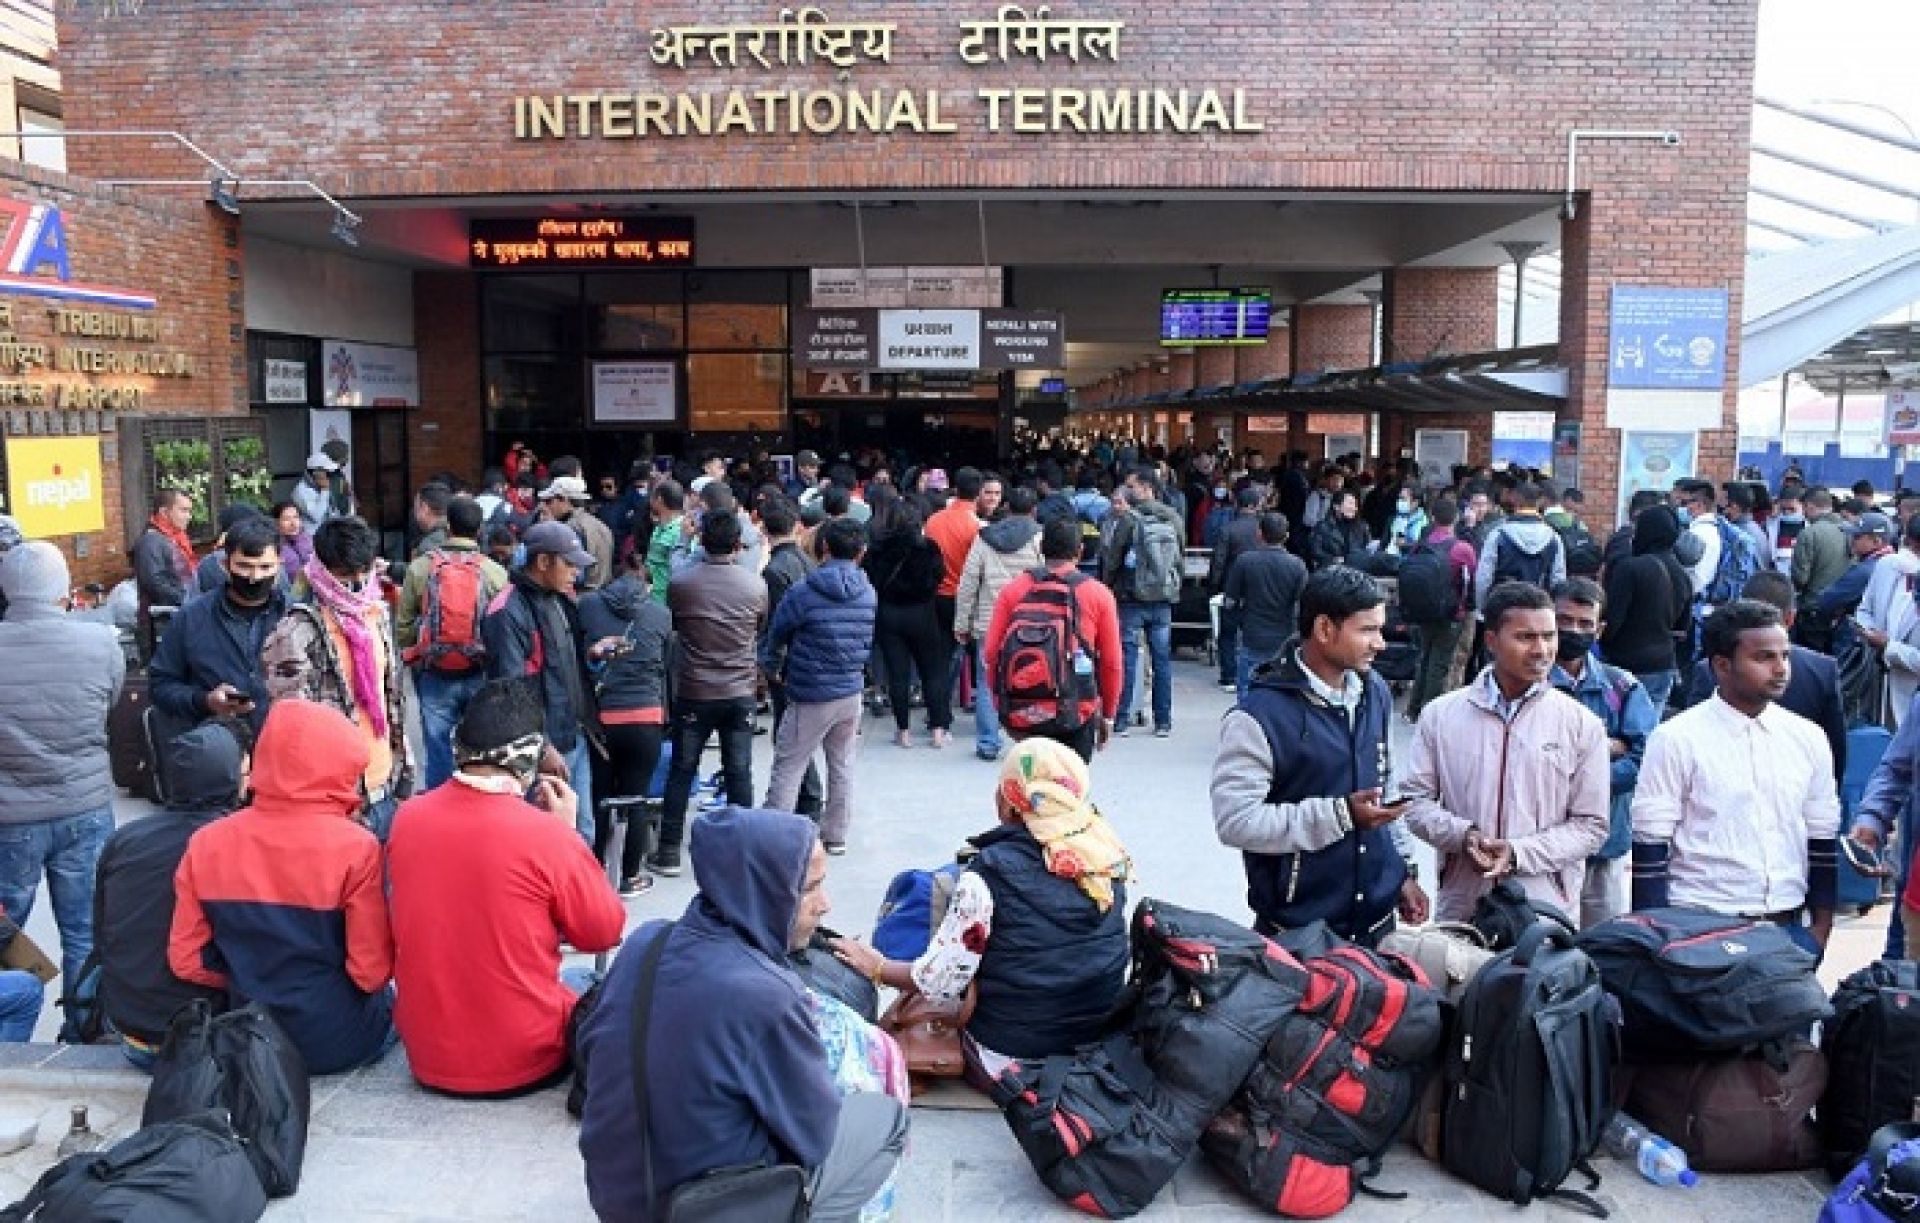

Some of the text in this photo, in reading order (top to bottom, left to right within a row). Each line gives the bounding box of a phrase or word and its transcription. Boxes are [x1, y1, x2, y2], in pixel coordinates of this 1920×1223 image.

[959, 4, 1125, 64] टर्मिनल
[514, 88, 1264, 139] INTERNATIONAL TERMINAL
[986, 320, 1057, 332] NEPALI WITH
[994, 336, 1049, 347] WORKING
[888, 345, 969, 360] DEPARTURE
[1008, 353, 1035, 363] VISA
[819, 370, 870, 393] A1
[26, 467, 92, 510] nepal
